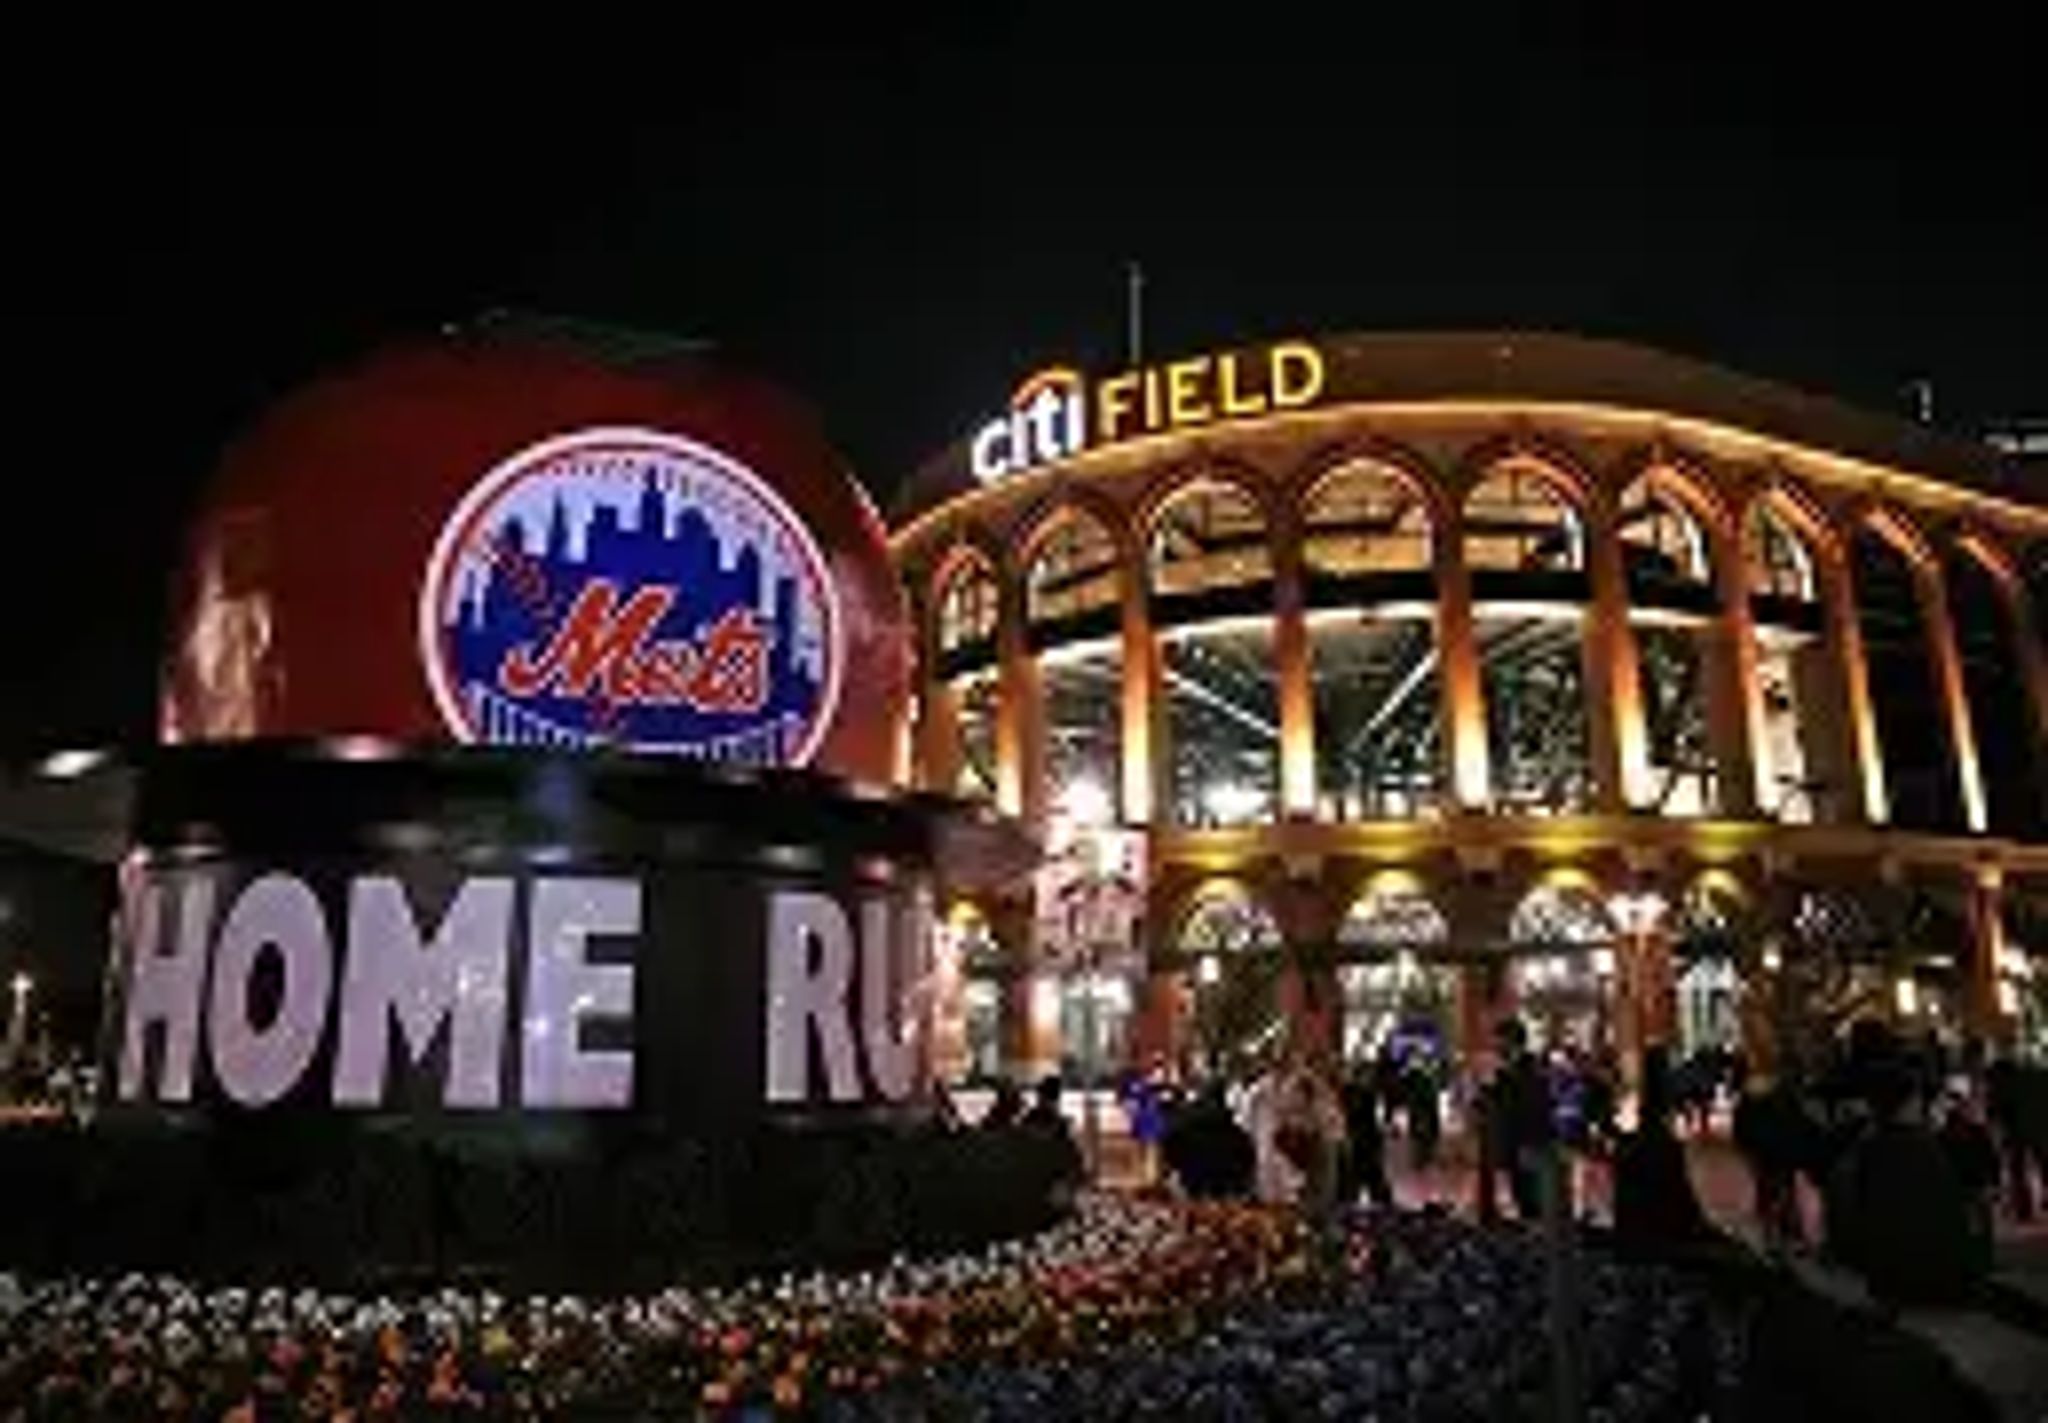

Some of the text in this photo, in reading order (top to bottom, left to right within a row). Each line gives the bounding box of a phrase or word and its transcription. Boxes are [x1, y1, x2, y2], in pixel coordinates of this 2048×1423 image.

[971, 345, 1323, 488] citi FIELD
[502, 578, 770, 713] Mets
[118, 870, 643, 1108] HOME
